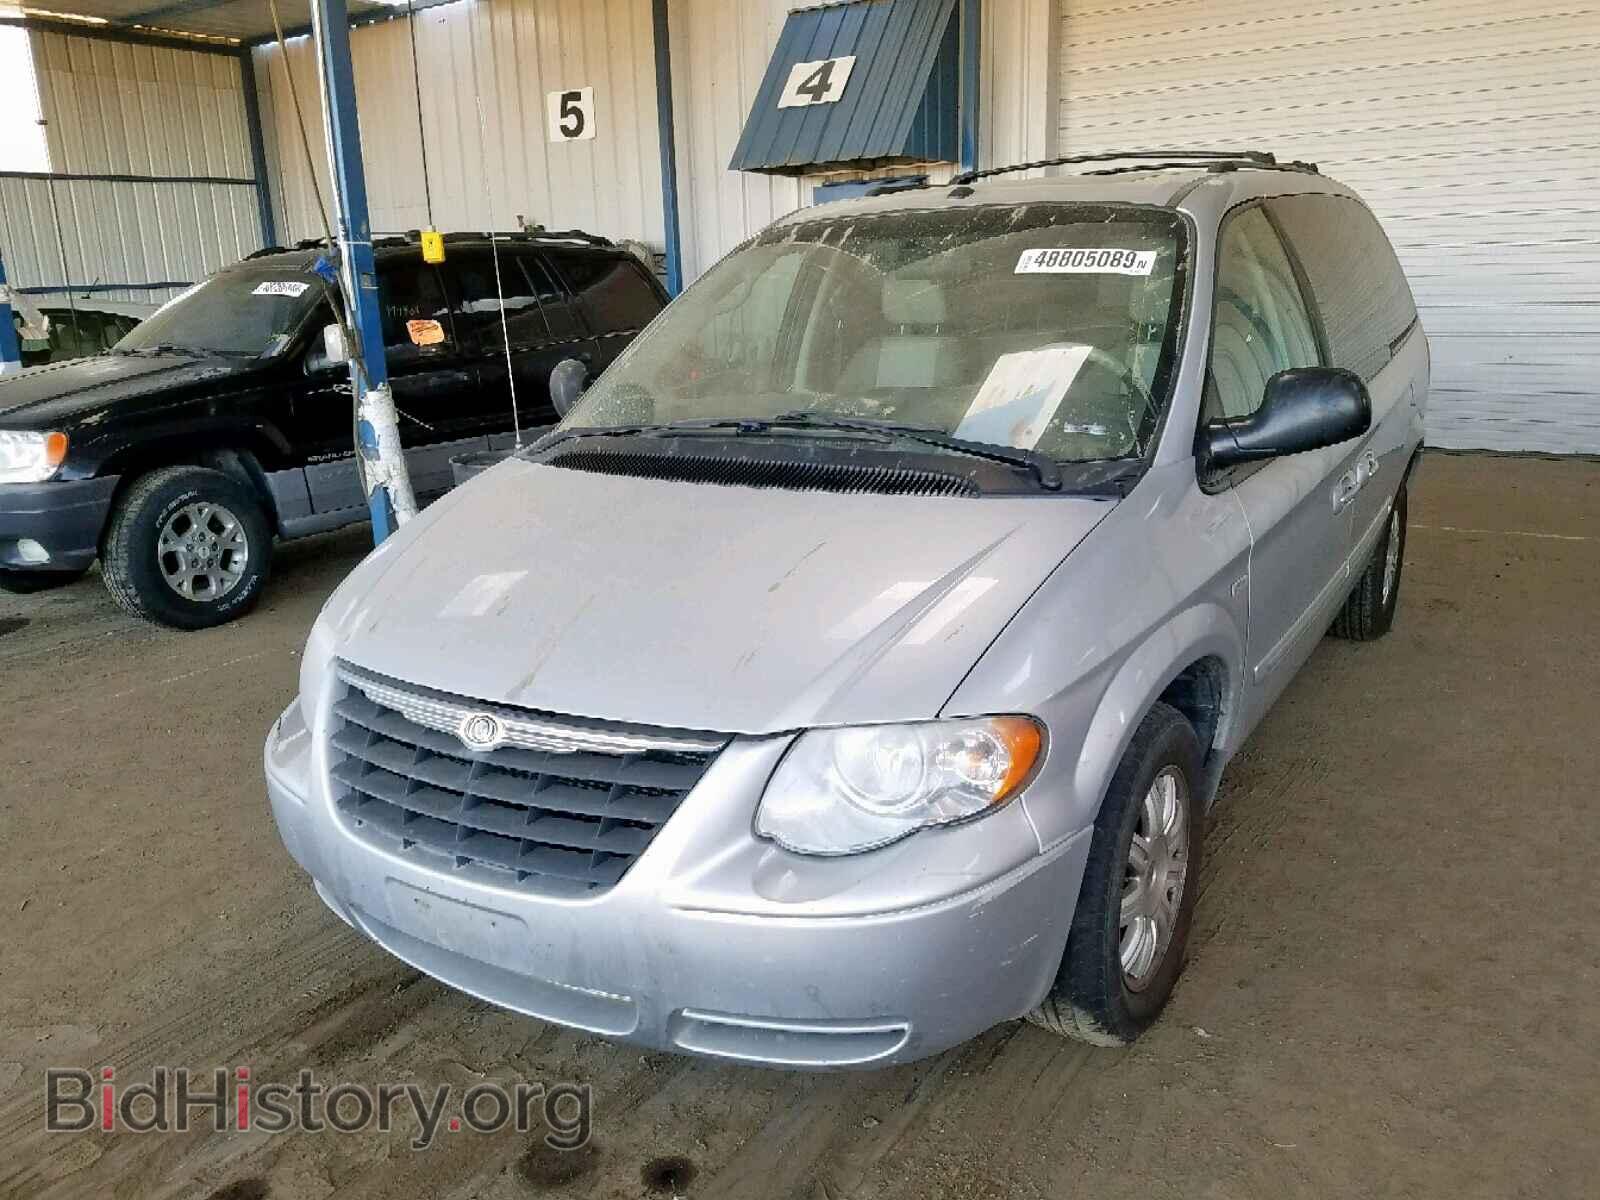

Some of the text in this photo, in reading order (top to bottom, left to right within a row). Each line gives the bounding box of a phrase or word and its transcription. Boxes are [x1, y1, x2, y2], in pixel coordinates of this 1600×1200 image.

[795, 60, 836, 102] 4
[560, 91, 584, 138] 5
[1034, 250, 1137, 269] 48805089
